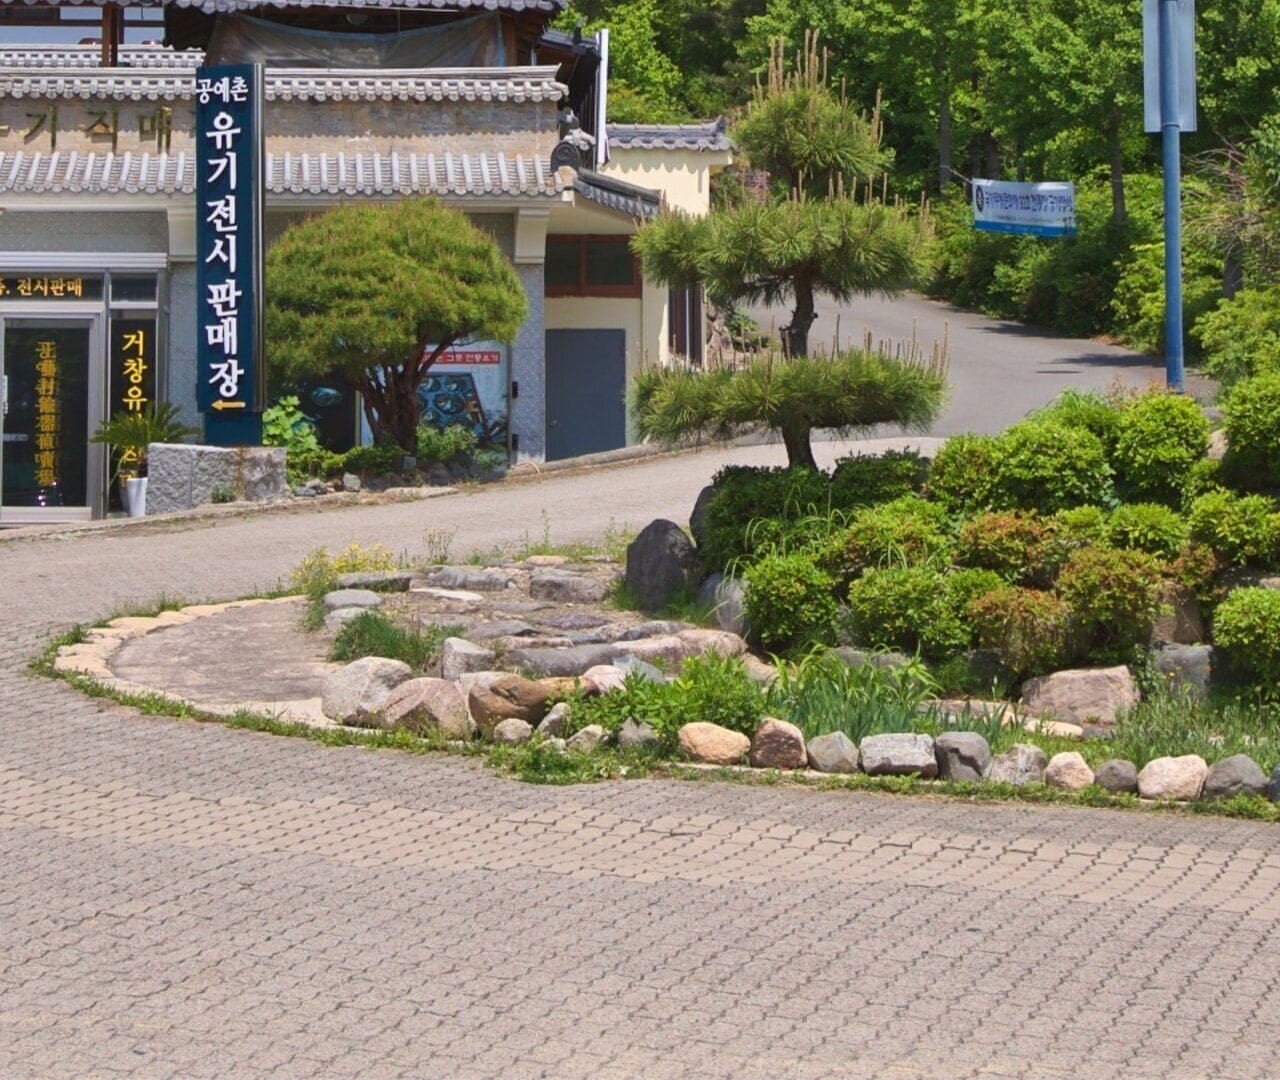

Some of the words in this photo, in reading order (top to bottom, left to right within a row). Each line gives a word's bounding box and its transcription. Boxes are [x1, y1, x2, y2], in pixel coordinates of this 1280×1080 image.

[195, 76, 249, 104] 공예촌
[205, 111, 245, 398] 유기전시판매장
[16, 276, 83, 297] 전시판매
